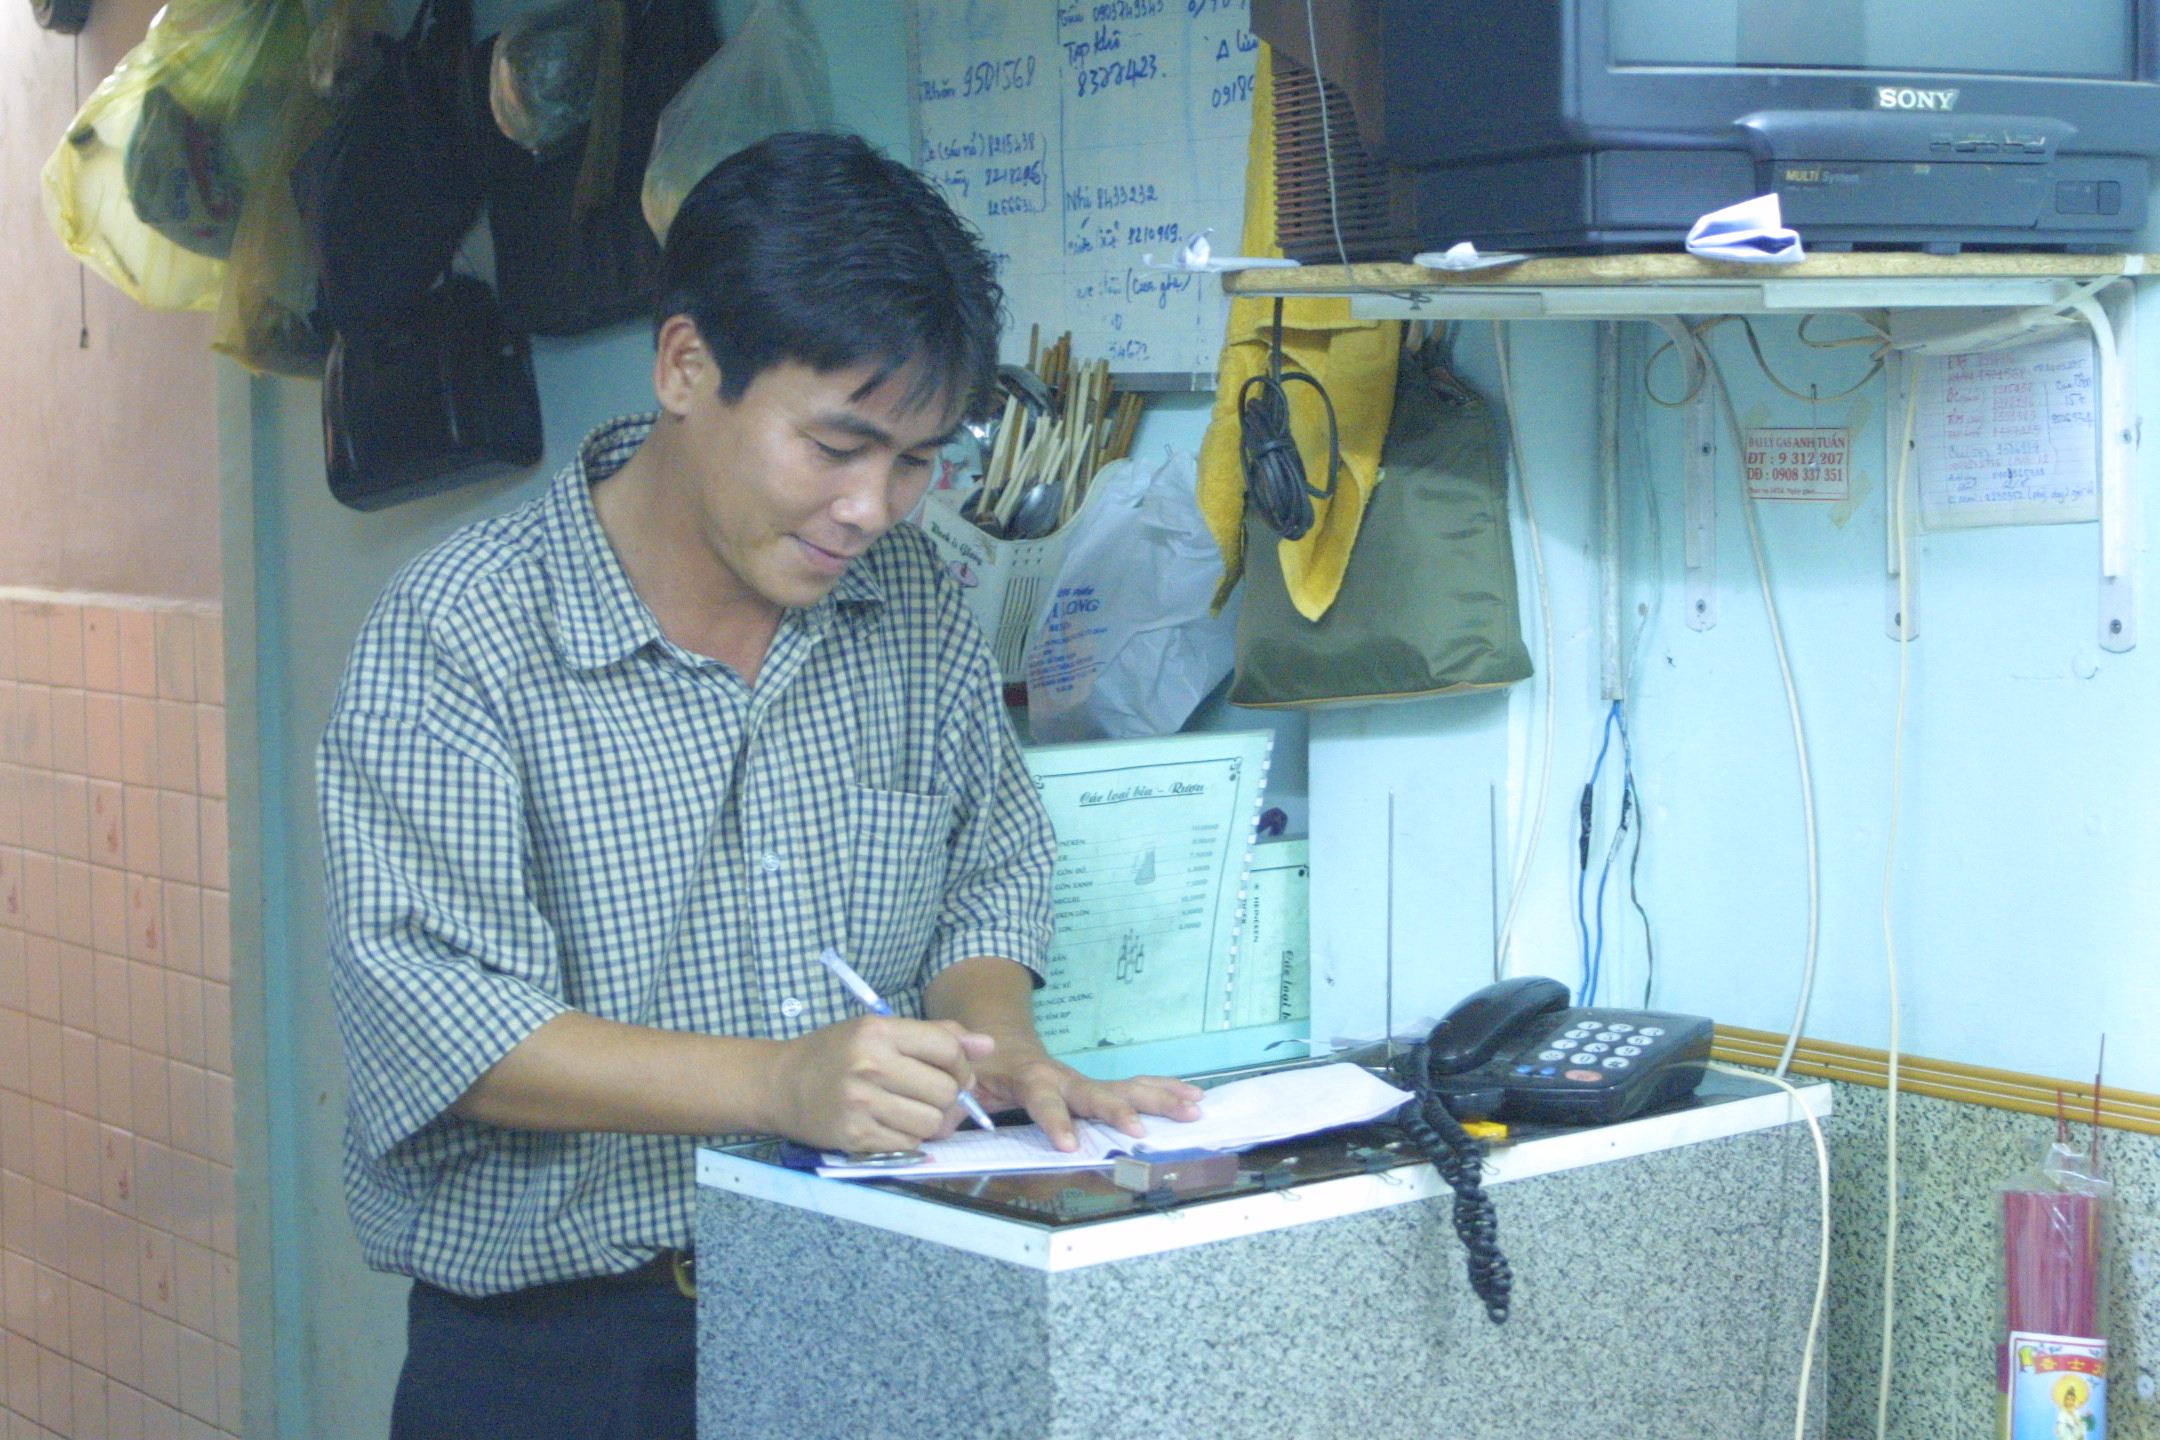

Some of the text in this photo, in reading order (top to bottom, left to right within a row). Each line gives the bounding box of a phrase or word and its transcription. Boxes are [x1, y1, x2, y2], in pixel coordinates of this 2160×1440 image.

[1878, 89, 1956, 110] SONY
[1793, 437, 1815, 449] ANH
[1817, 432, 1846, 449] TUẤN
[1778, 452, 1787, 464] 9
[1791, 451, 1815, 464] 312
[1819, 451, 1844, 465] 207
[1772, 467, 1799, 481] 0908
[1824, 467, 1843, 482] 351
